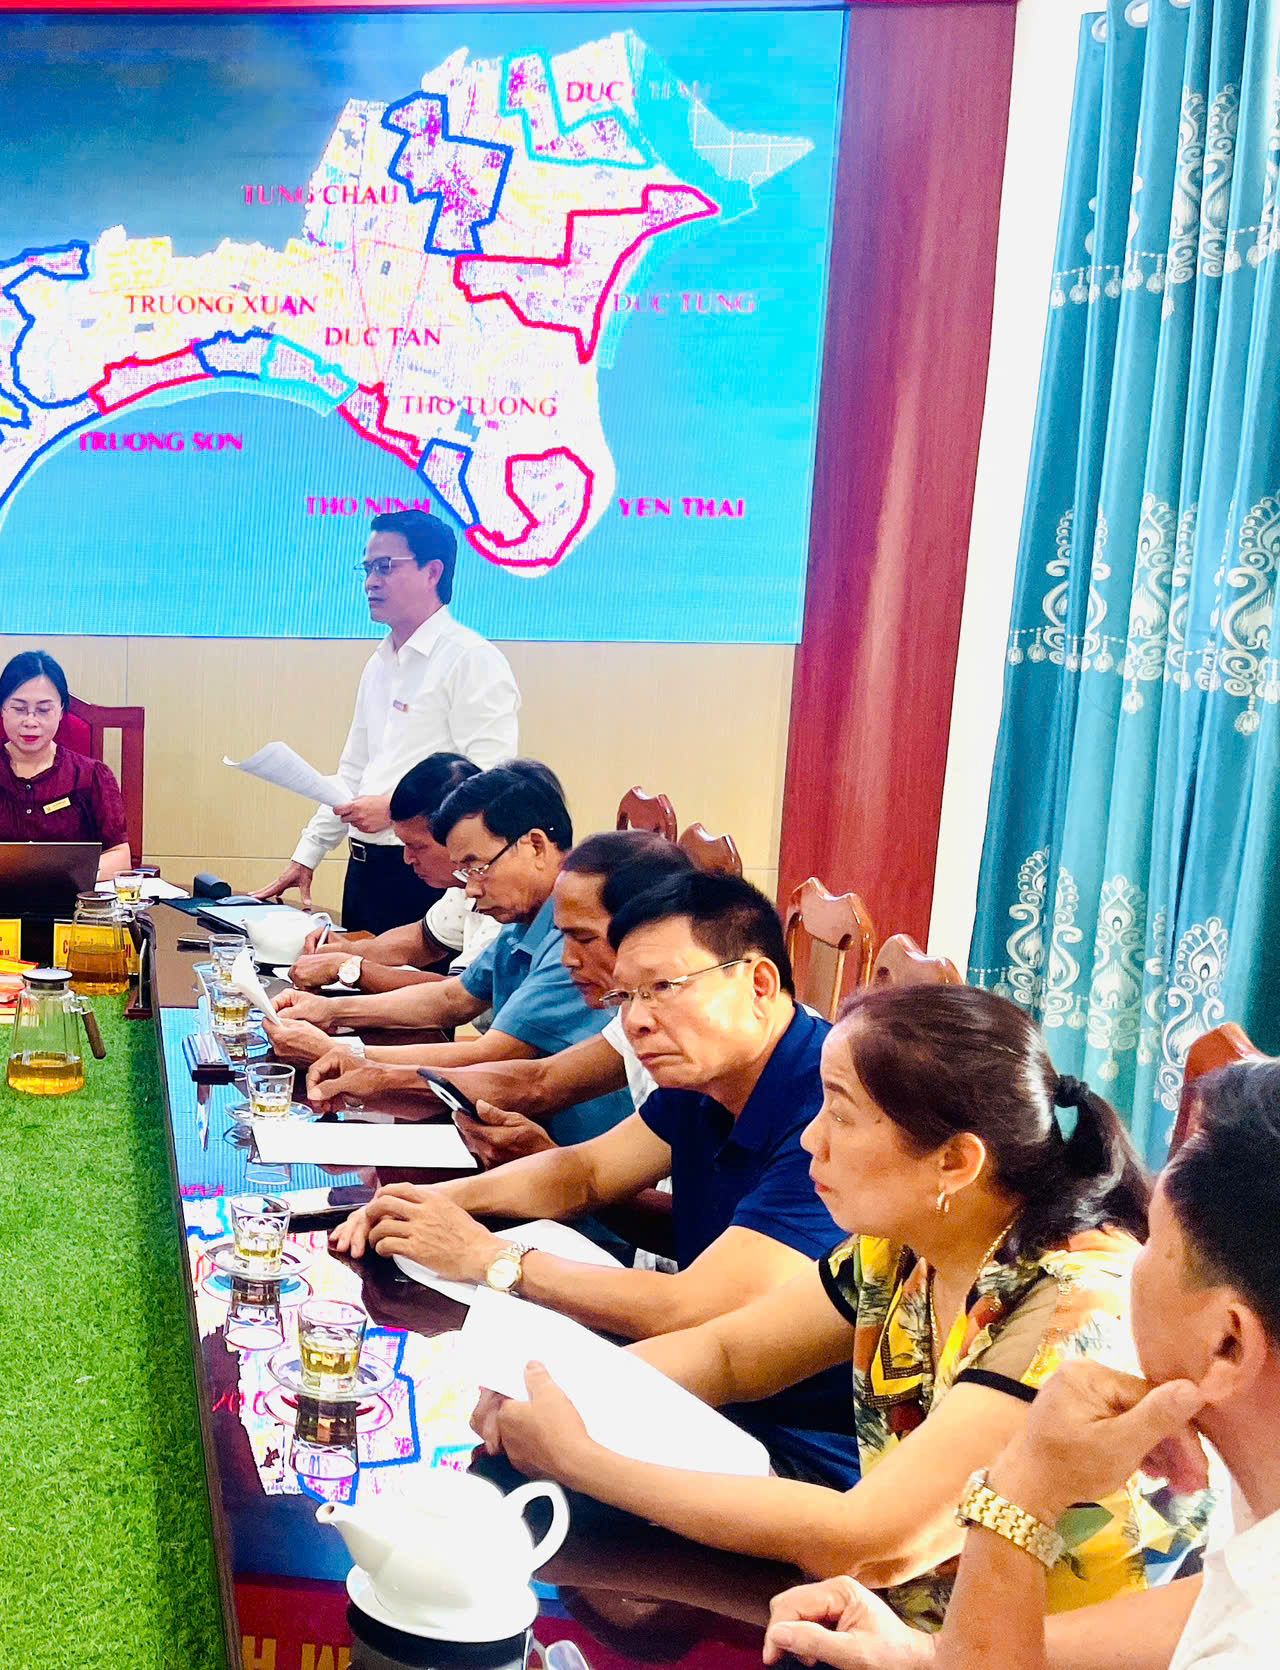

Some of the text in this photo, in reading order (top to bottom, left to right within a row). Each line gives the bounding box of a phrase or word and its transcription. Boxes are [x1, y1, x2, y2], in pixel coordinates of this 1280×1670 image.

[566, 81, 624, 103] DUC
[243, 184, 399, 206] TUNG CHAU
[125, 294, 319, 319] TRUONG XUAN
[613, 292, 757, 315] DUC TUNG
[323, 327, 442, 347] DUC TAN
[400, 395, 558, 418] THO TUONG
[78, 431, 243, 453] TRUONG SON
[305, 496, 432, 516] THO NINH
[617, 496, 746, 519] YEN THAI
